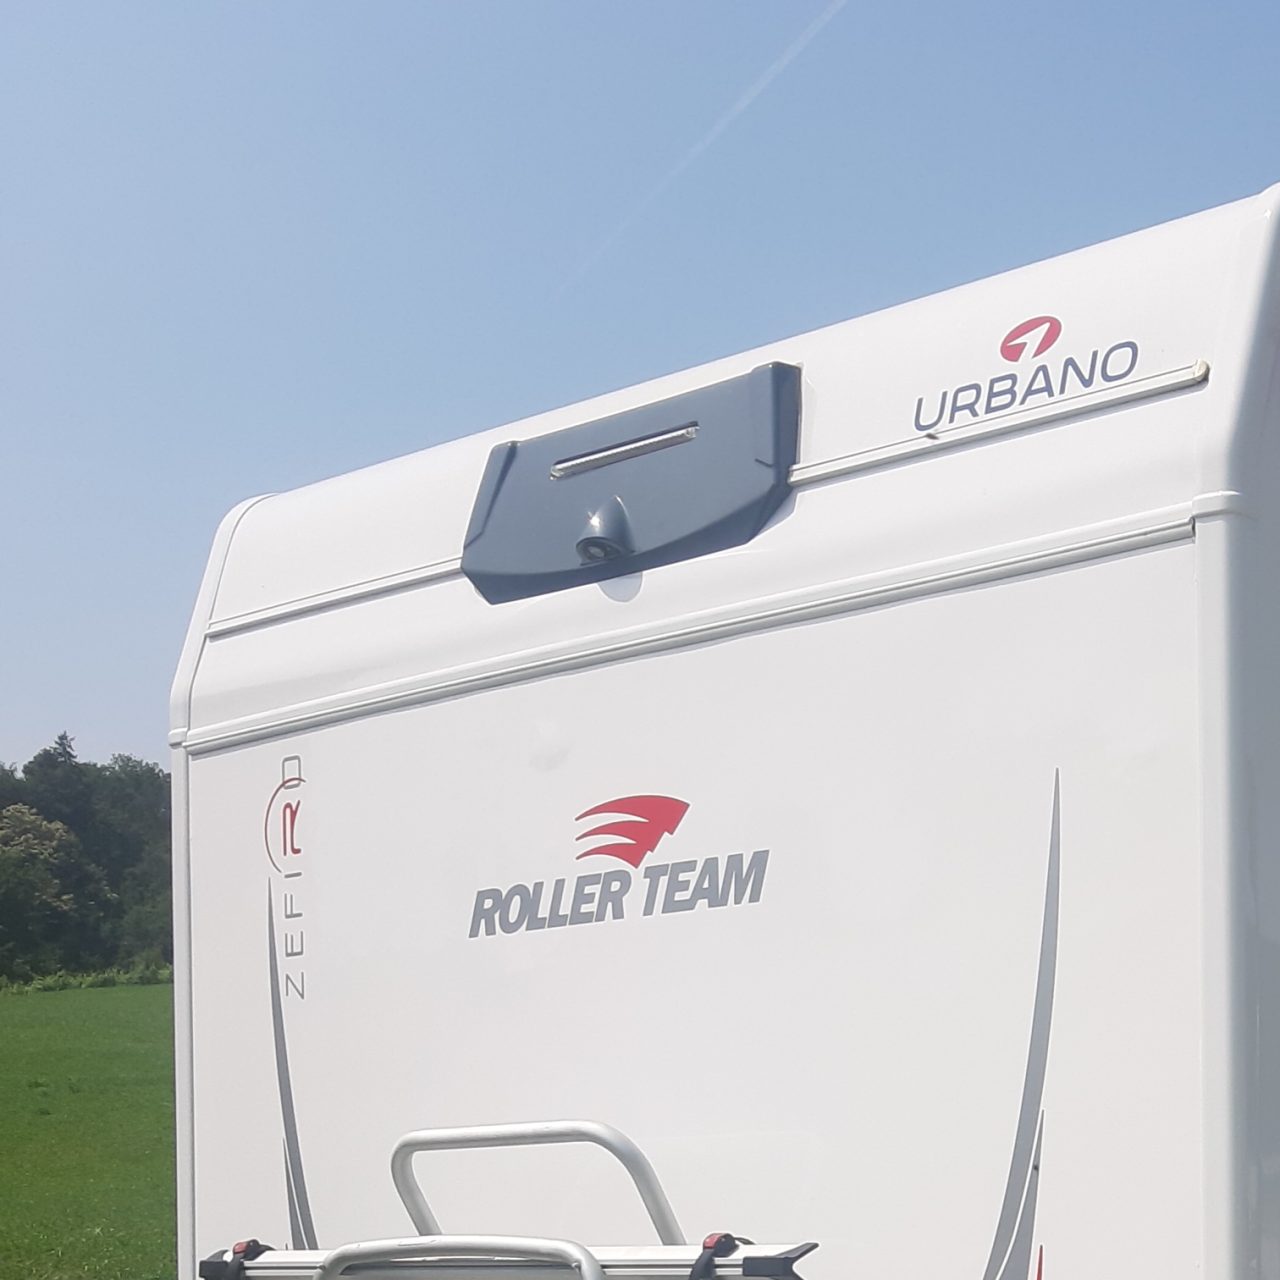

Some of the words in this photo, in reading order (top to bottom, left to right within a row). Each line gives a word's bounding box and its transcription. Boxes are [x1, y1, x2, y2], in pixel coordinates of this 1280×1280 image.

[914, 341, 1139, 432] URBANO
[280, 754, 306, 1001] ZEFIRO
[468, 869, 633, 939] ROLLER
[643, 849, 770, 917] TEAM
